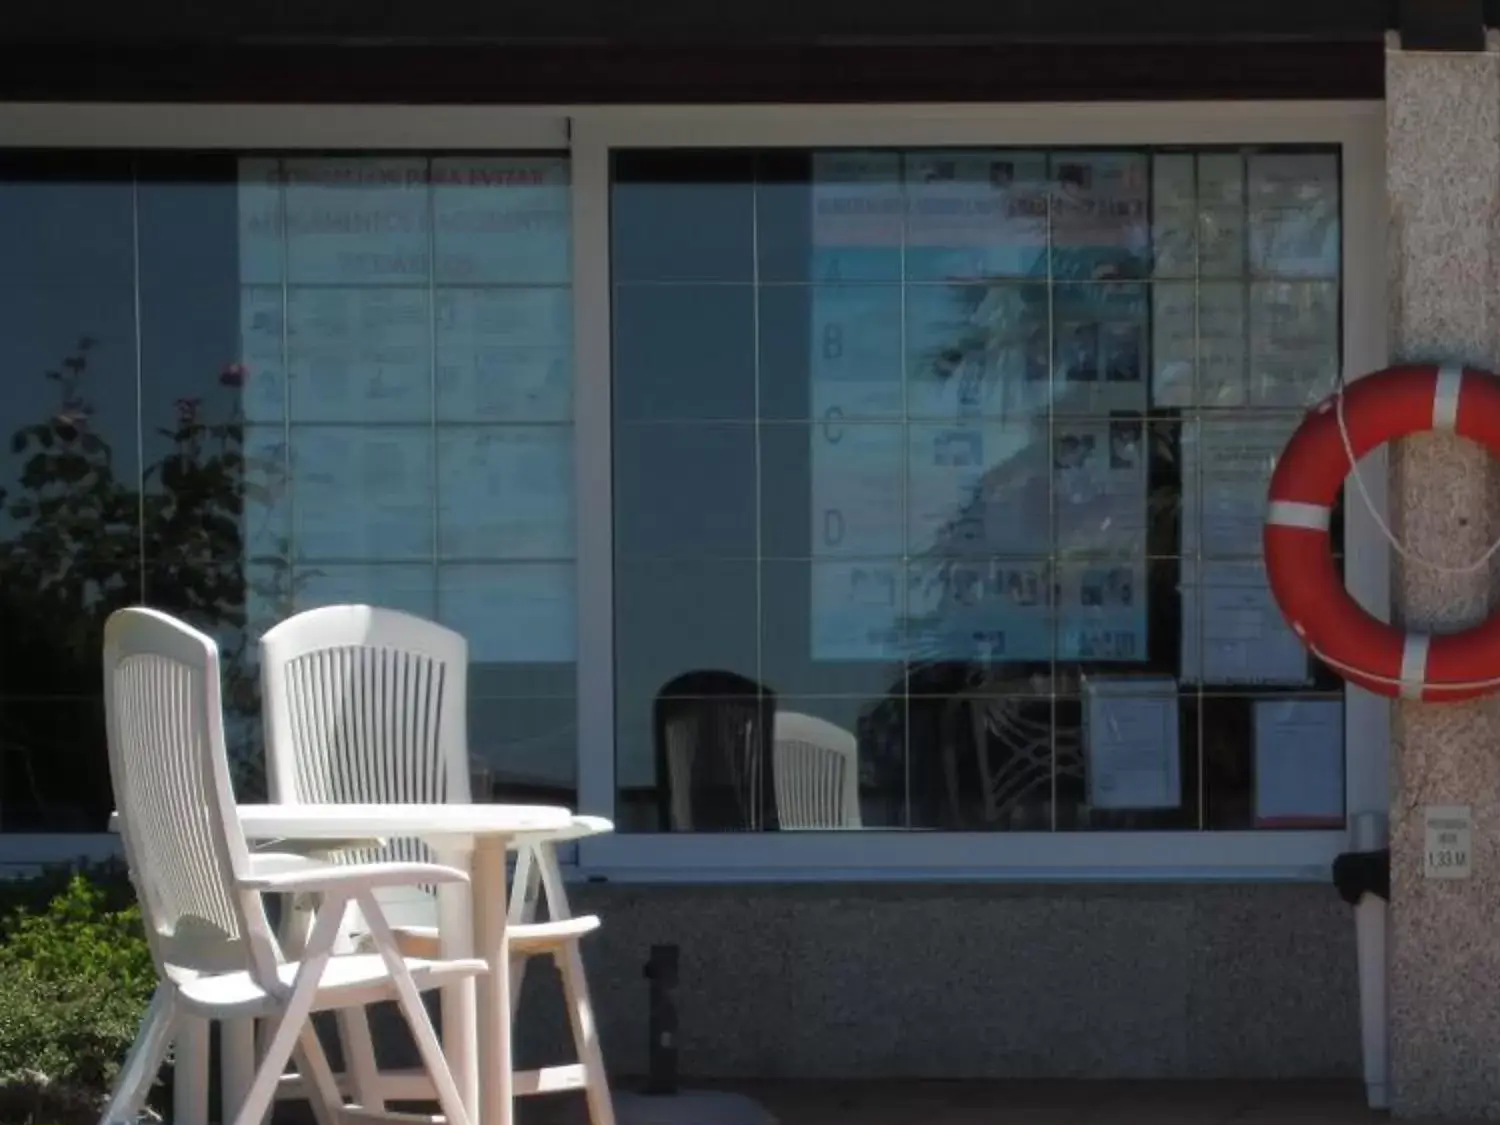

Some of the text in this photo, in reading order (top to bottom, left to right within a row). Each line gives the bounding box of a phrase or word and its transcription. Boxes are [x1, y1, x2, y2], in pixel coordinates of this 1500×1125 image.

[822, 323, 844, 359] B
[822, 405, 845, 445] C
[823, 508, 846, 546] D
